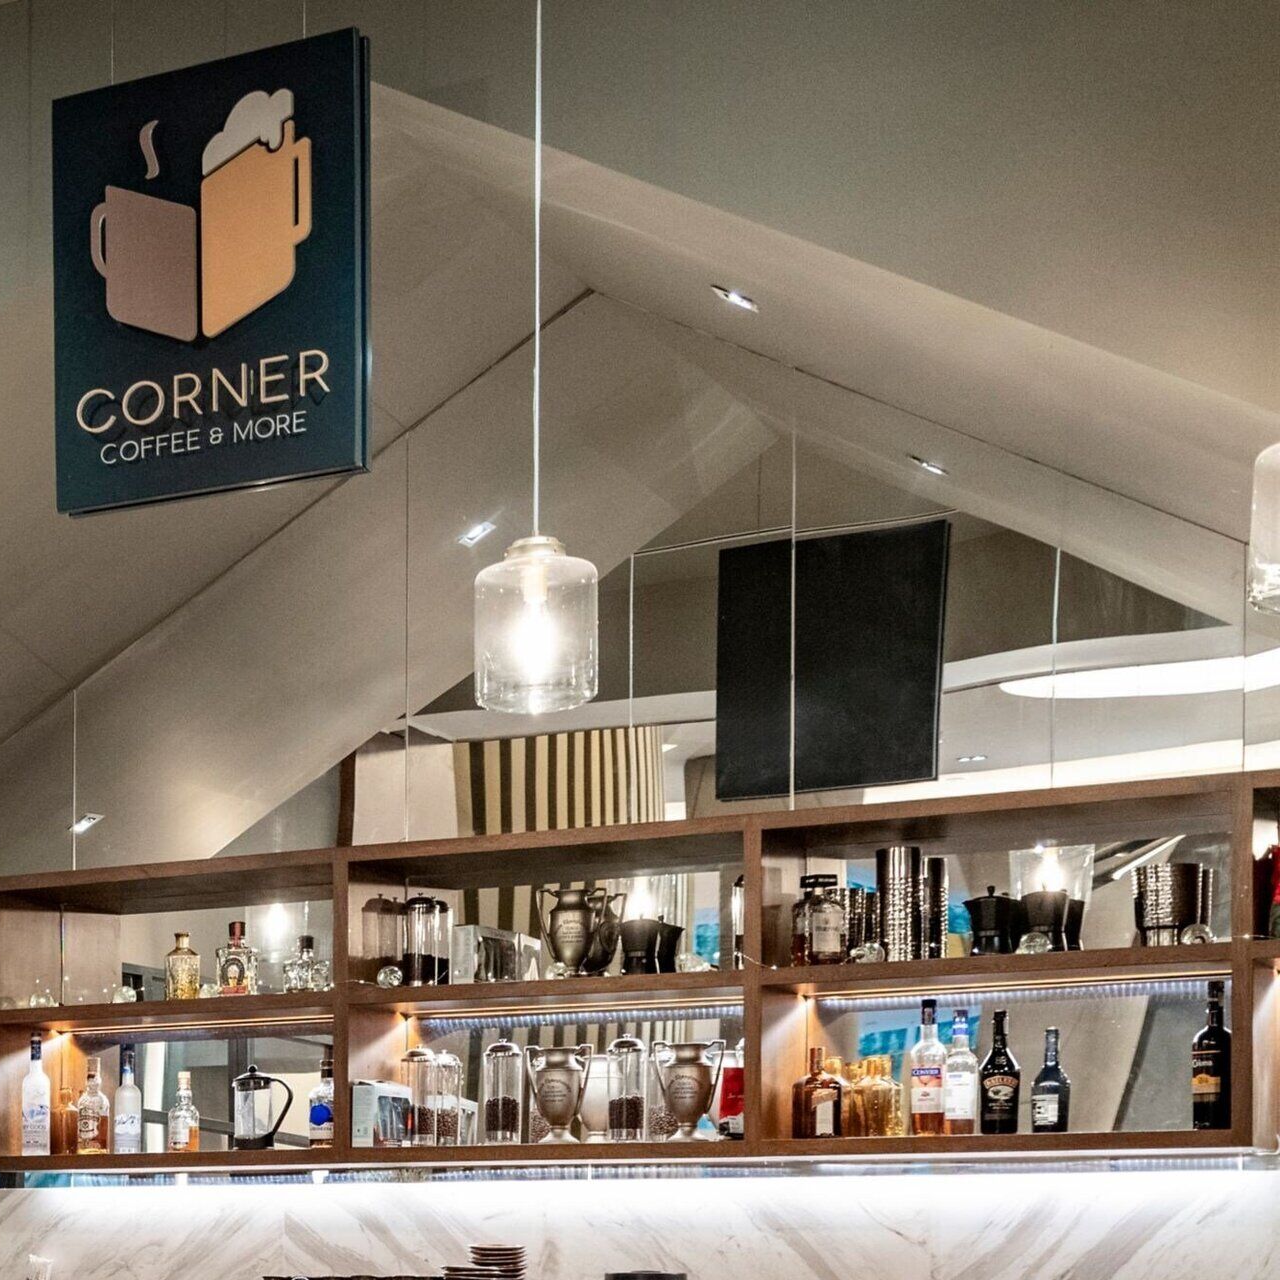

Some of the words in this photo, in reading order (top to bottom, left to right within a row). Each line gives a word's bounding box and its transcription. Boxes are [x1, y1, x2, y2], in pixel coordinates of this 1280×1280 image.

[76, 349, 330, 434] CORNER
[100, 429, 200, 464] COFFEE
[209, 427, 224, 444] &
[233, 410, 307, 443] MORE
